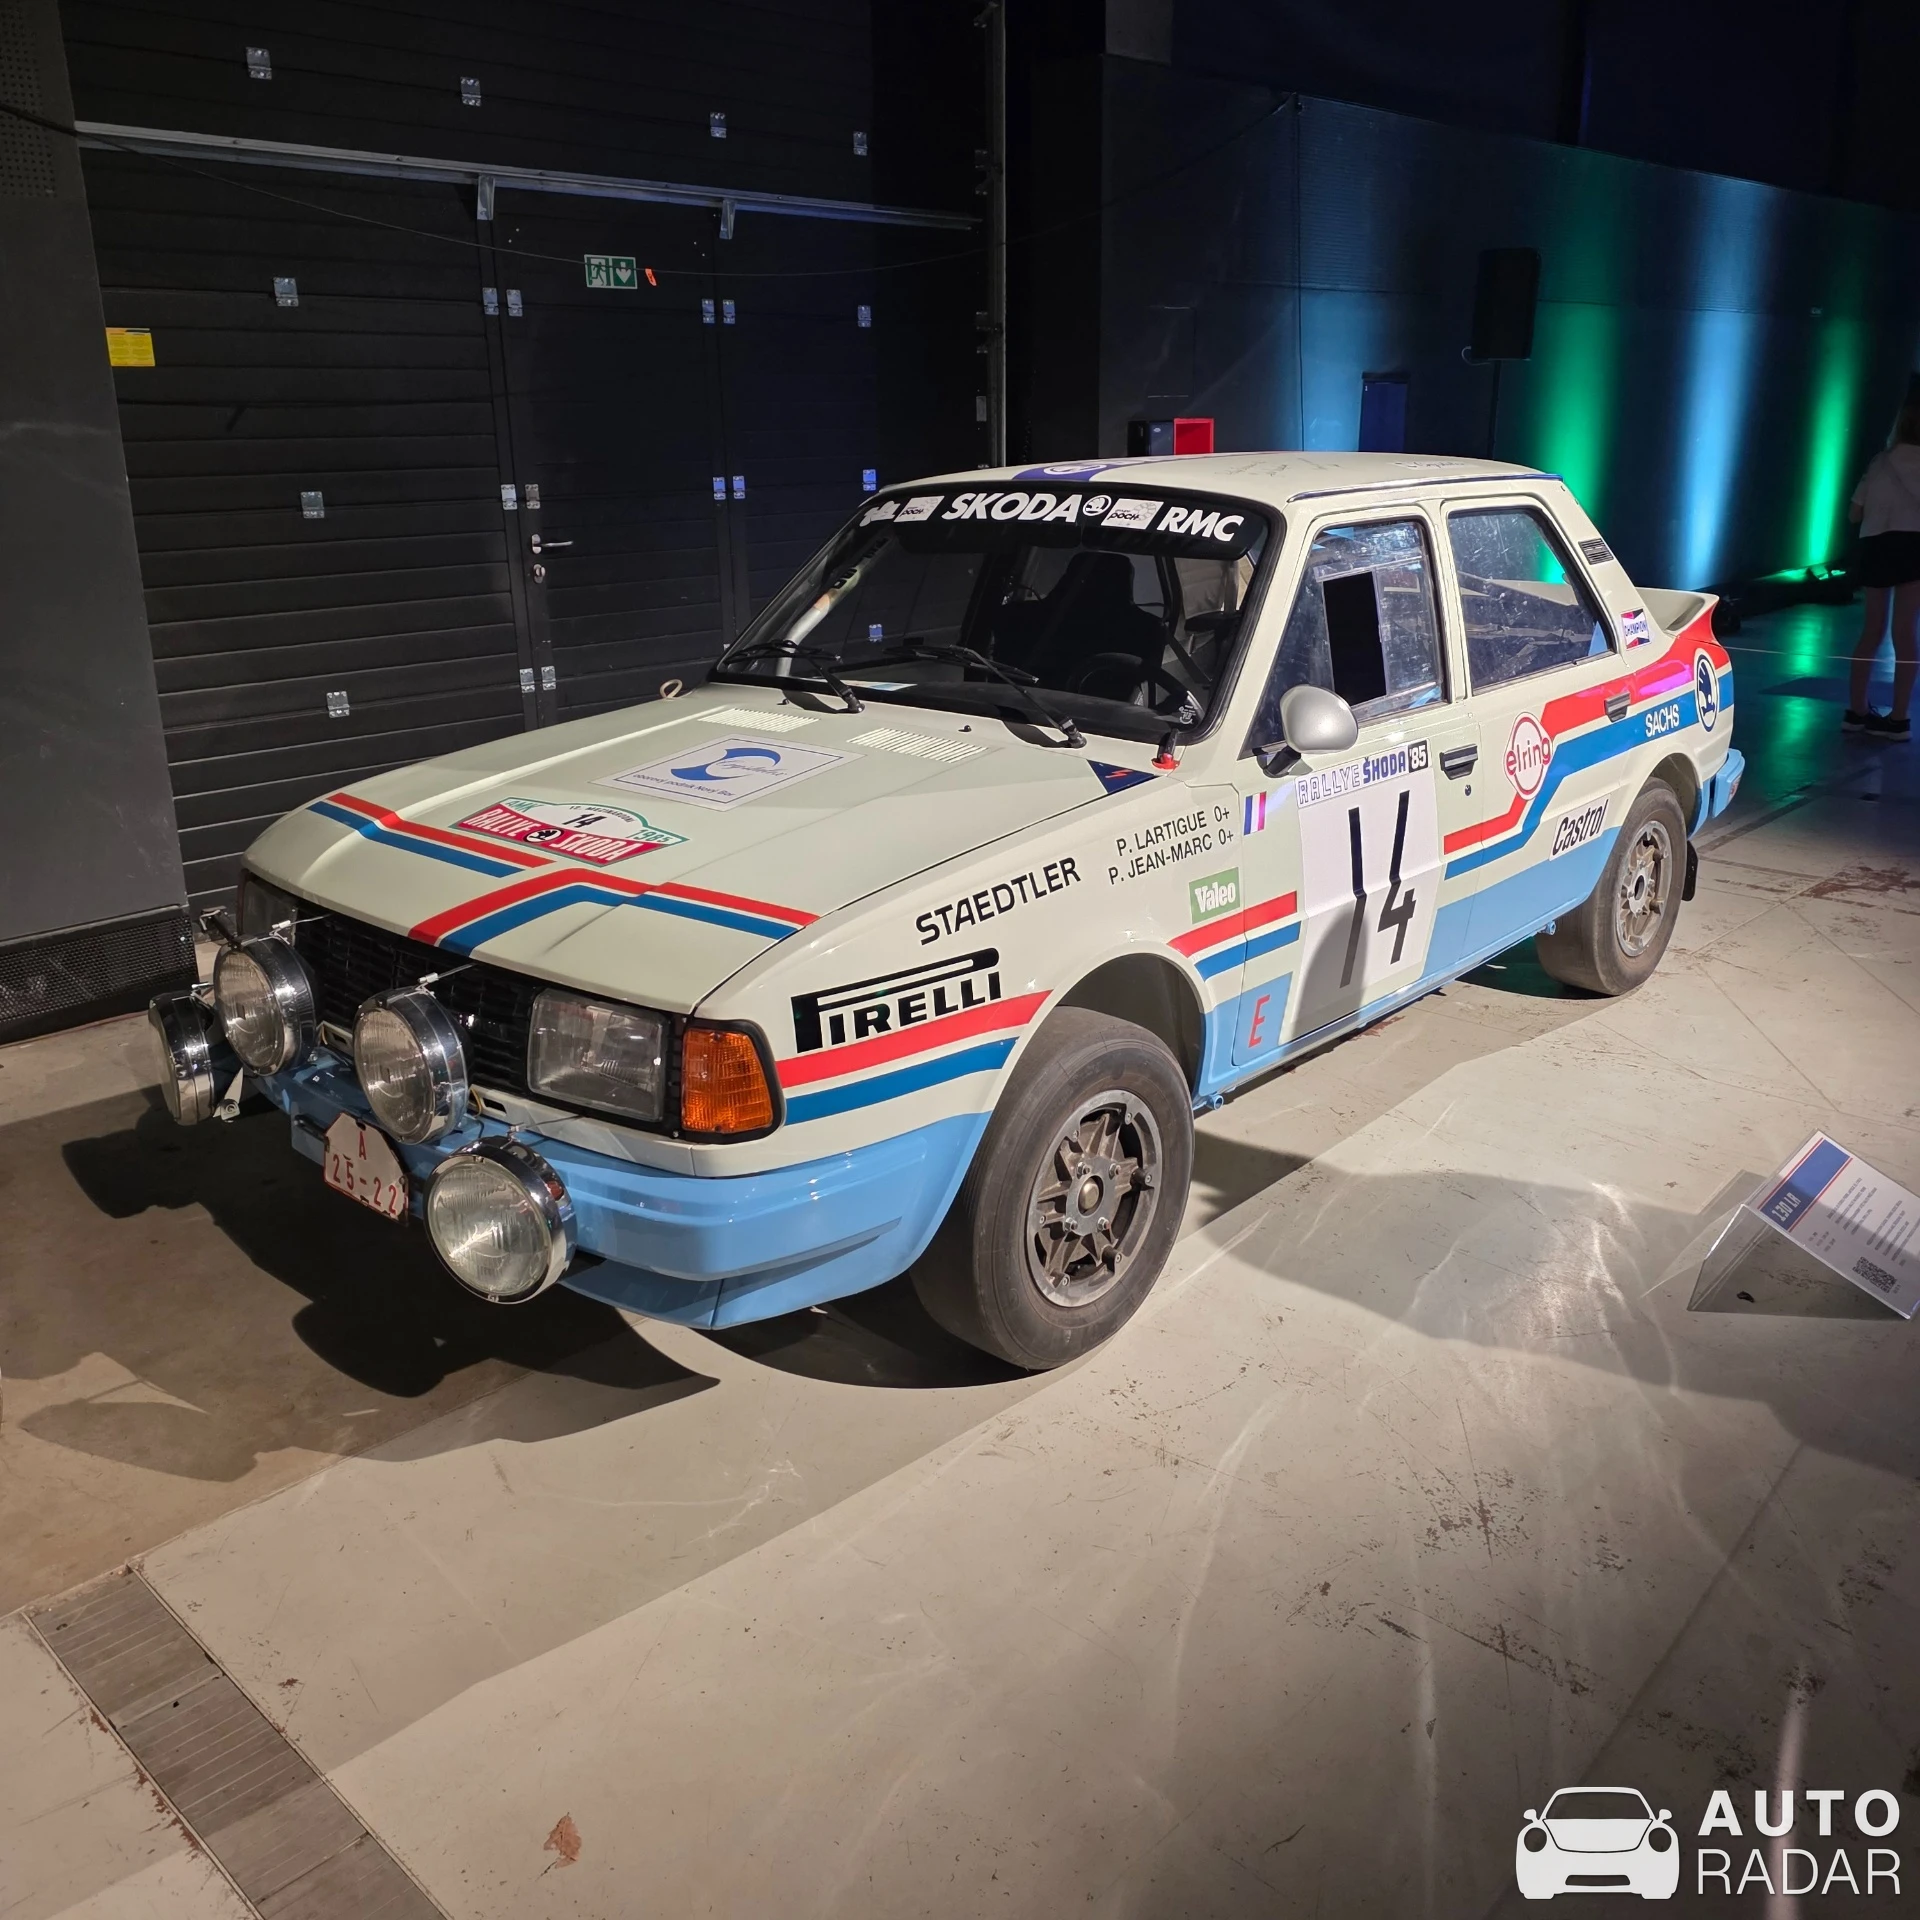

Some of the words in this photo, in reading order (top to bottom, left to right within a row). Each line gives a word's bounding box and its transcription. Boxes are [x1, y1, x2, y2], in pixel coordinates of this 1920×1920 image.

[941, 493, 1083, 523] SKODA
[1156, 506, 1245, 542] RMC
[1645, 704, 1680, 737] SACHS
[1298, 764, 1361, 804] RALLYE
[1409, 745, 1427, 770] '85
[1505, 737, 1551, 777] elring
[462, 808, 541, 837] RALLYE
[562, 813, 607, 828] 14
[625, 829, 672, 843] 1985
[1116, 838, 1133, 857] P.
[1135, 811, 1207, 851] LARTIGUE
[1552, 799, 1609, 856] Castrol
[1108, 866, 1124, 885] P.
[1128, 834, 1212, 878] JEAN-MARC
[915, 857, 1081, 945] STAEDTLER
[1195, 881, 1236, 913] Valeo
[1339, 790, 1417, 989] 14
[791, 948, 1001, 1053] PIRELLI
[359, 1130, 367, 1160] A
[333, 1154, 397, 1215] 25-22
[1771, 1201, 1793, 1222] 130
[1784, 1192, 1801, 1208] LR
